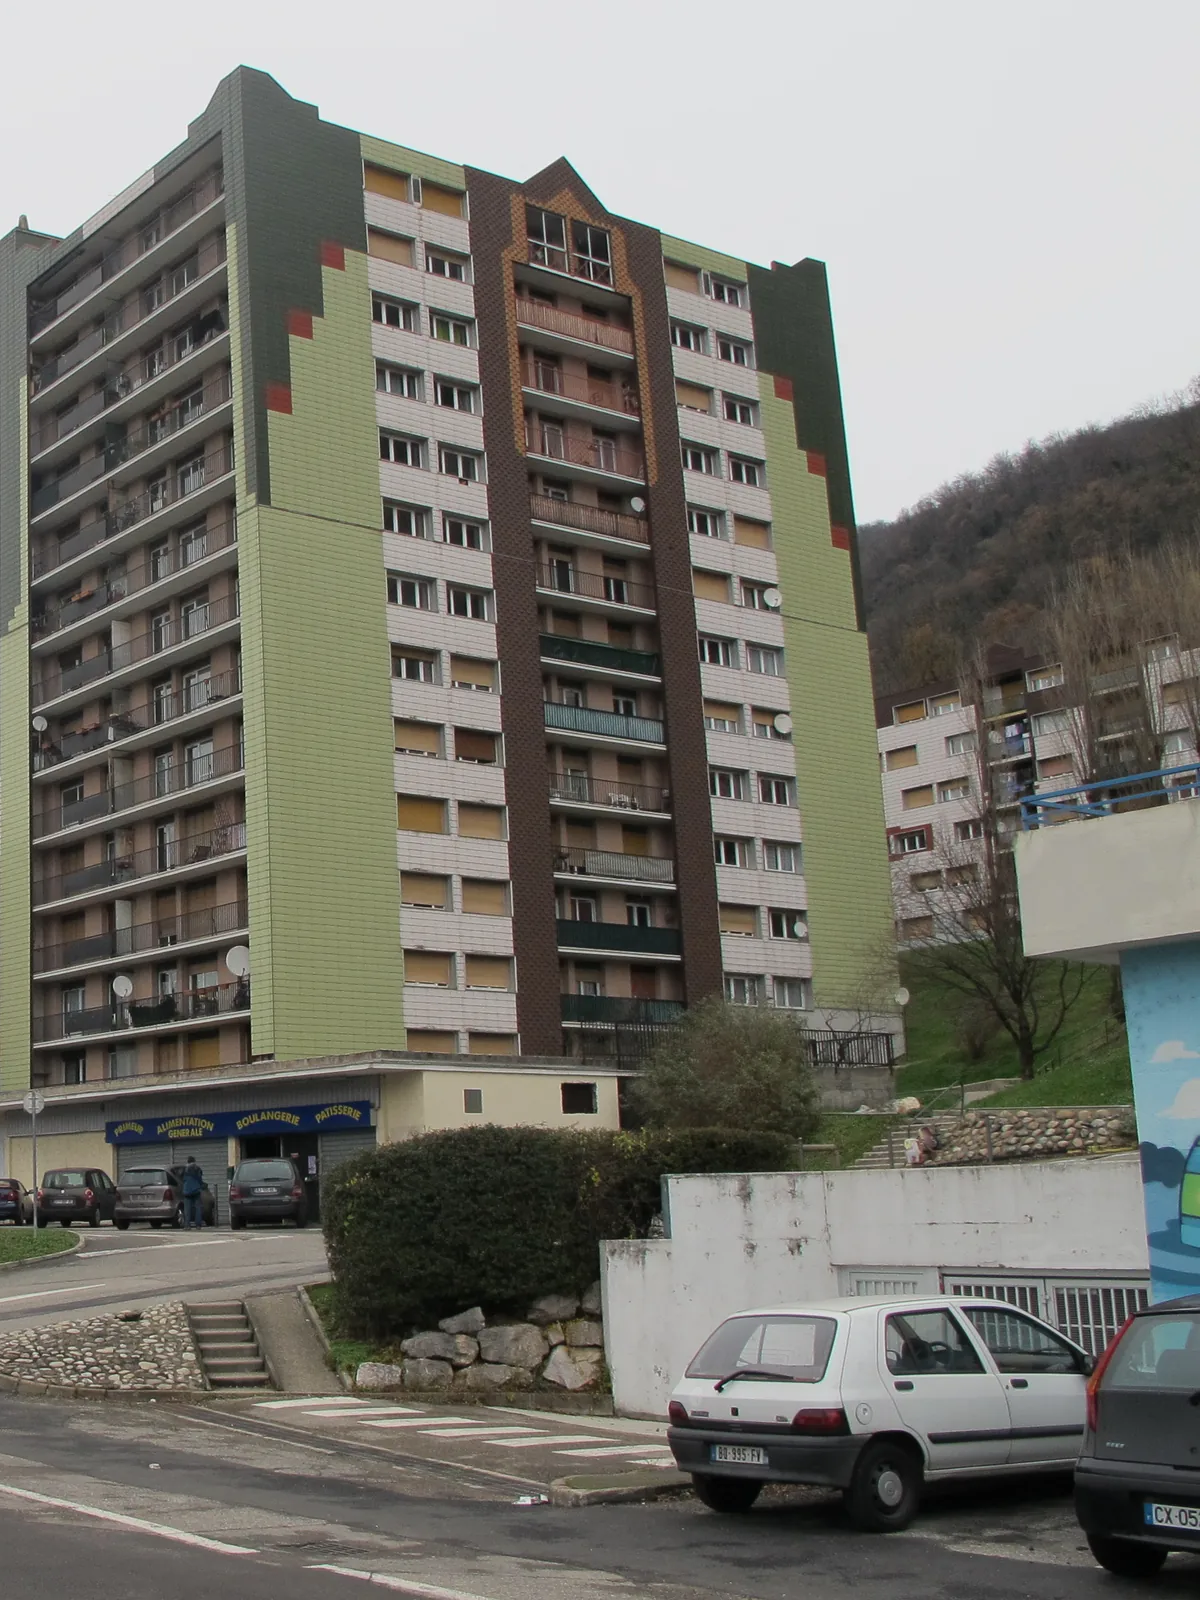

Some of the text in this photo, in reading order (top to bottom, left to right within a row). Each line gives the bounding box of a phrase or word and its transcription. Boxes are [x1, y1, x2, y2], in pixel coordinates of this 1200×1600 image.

[236, 1110, 300, 1130] BOULANGERIE
[315, 1105, 362, 1123] PATISSERIE
[114, 1121, 144, 1137] PRIMEUR
[157, 1117, 214, 1135] ALIMENTATION
[1154, 1506, 1200, 1527] CX-05
